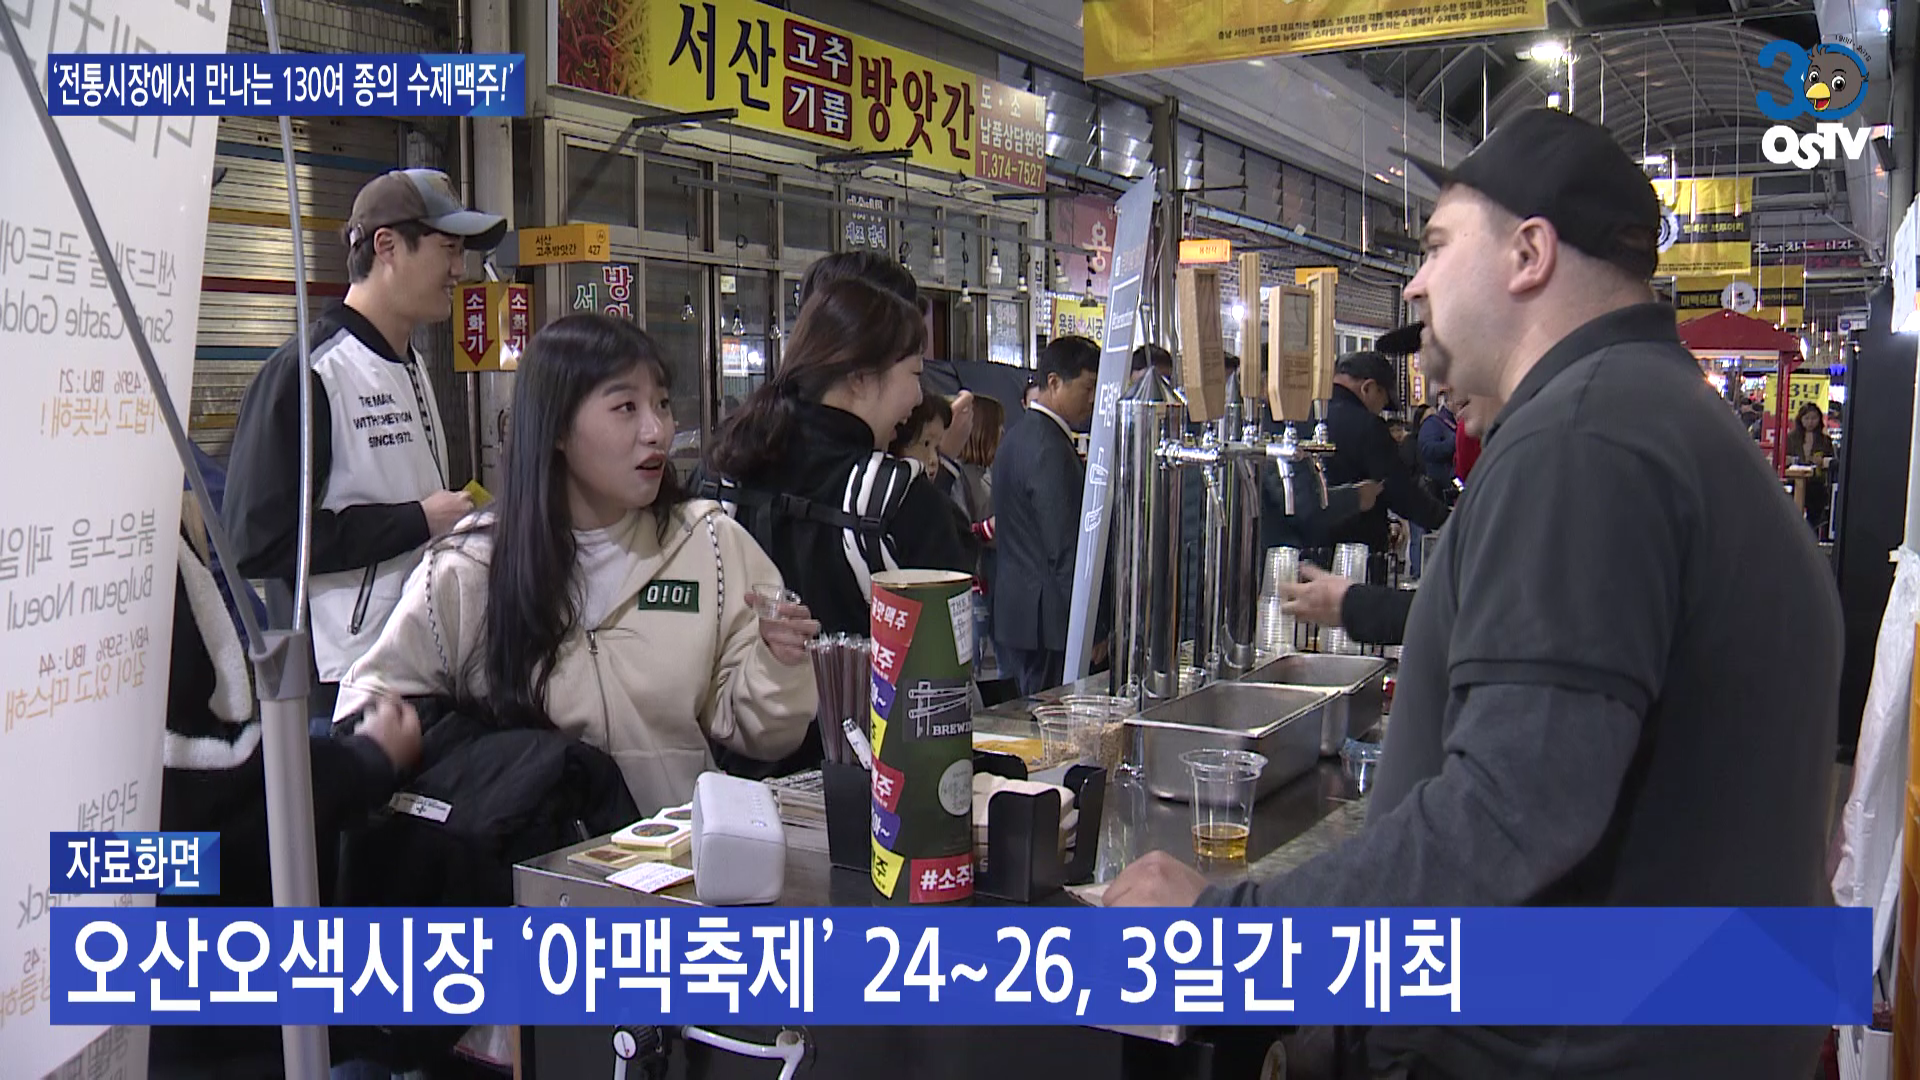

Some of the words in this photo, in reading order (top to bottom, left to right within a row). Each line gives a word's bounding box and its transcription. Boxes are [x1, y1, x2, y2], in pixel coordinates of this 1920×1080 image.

[668, 3, 776, 112] 서산
[788, 27, 850, 79] 고추
[858, 56, 975, 160] 방앗간
[787, 84, 850, 135] 기름
[980, 116, 1045, 160] 납품상담환영
[980, 150, 1043, 188] T.374-7527
[535, 234, 552, 246] 서산
[587, 244, 602, 256] 427
[465, 292, 486, 355] 소화기
[368, 433, 396, 449] SINCE
